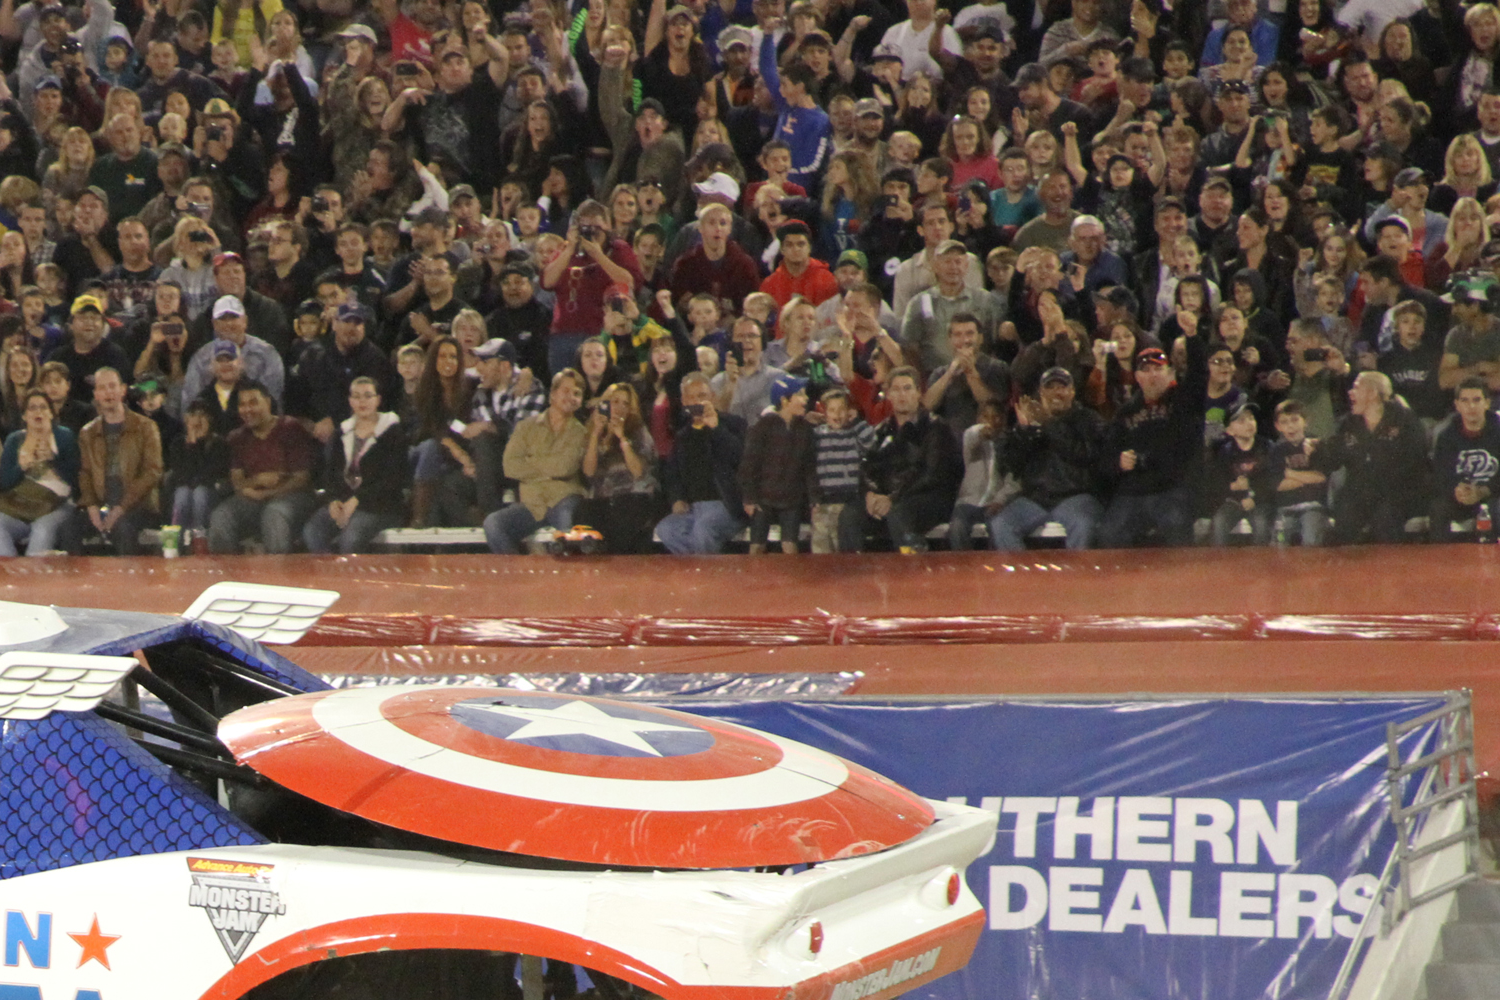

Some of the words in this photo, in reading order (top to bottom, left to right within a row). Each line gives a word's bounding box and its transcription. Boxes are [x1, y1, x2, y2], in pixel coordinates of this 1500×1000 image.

[189, 884, 286, 916] MONSTER
[989, 865, 1385, 939] DEALERS
[212, 907, 260, 933] JAM
